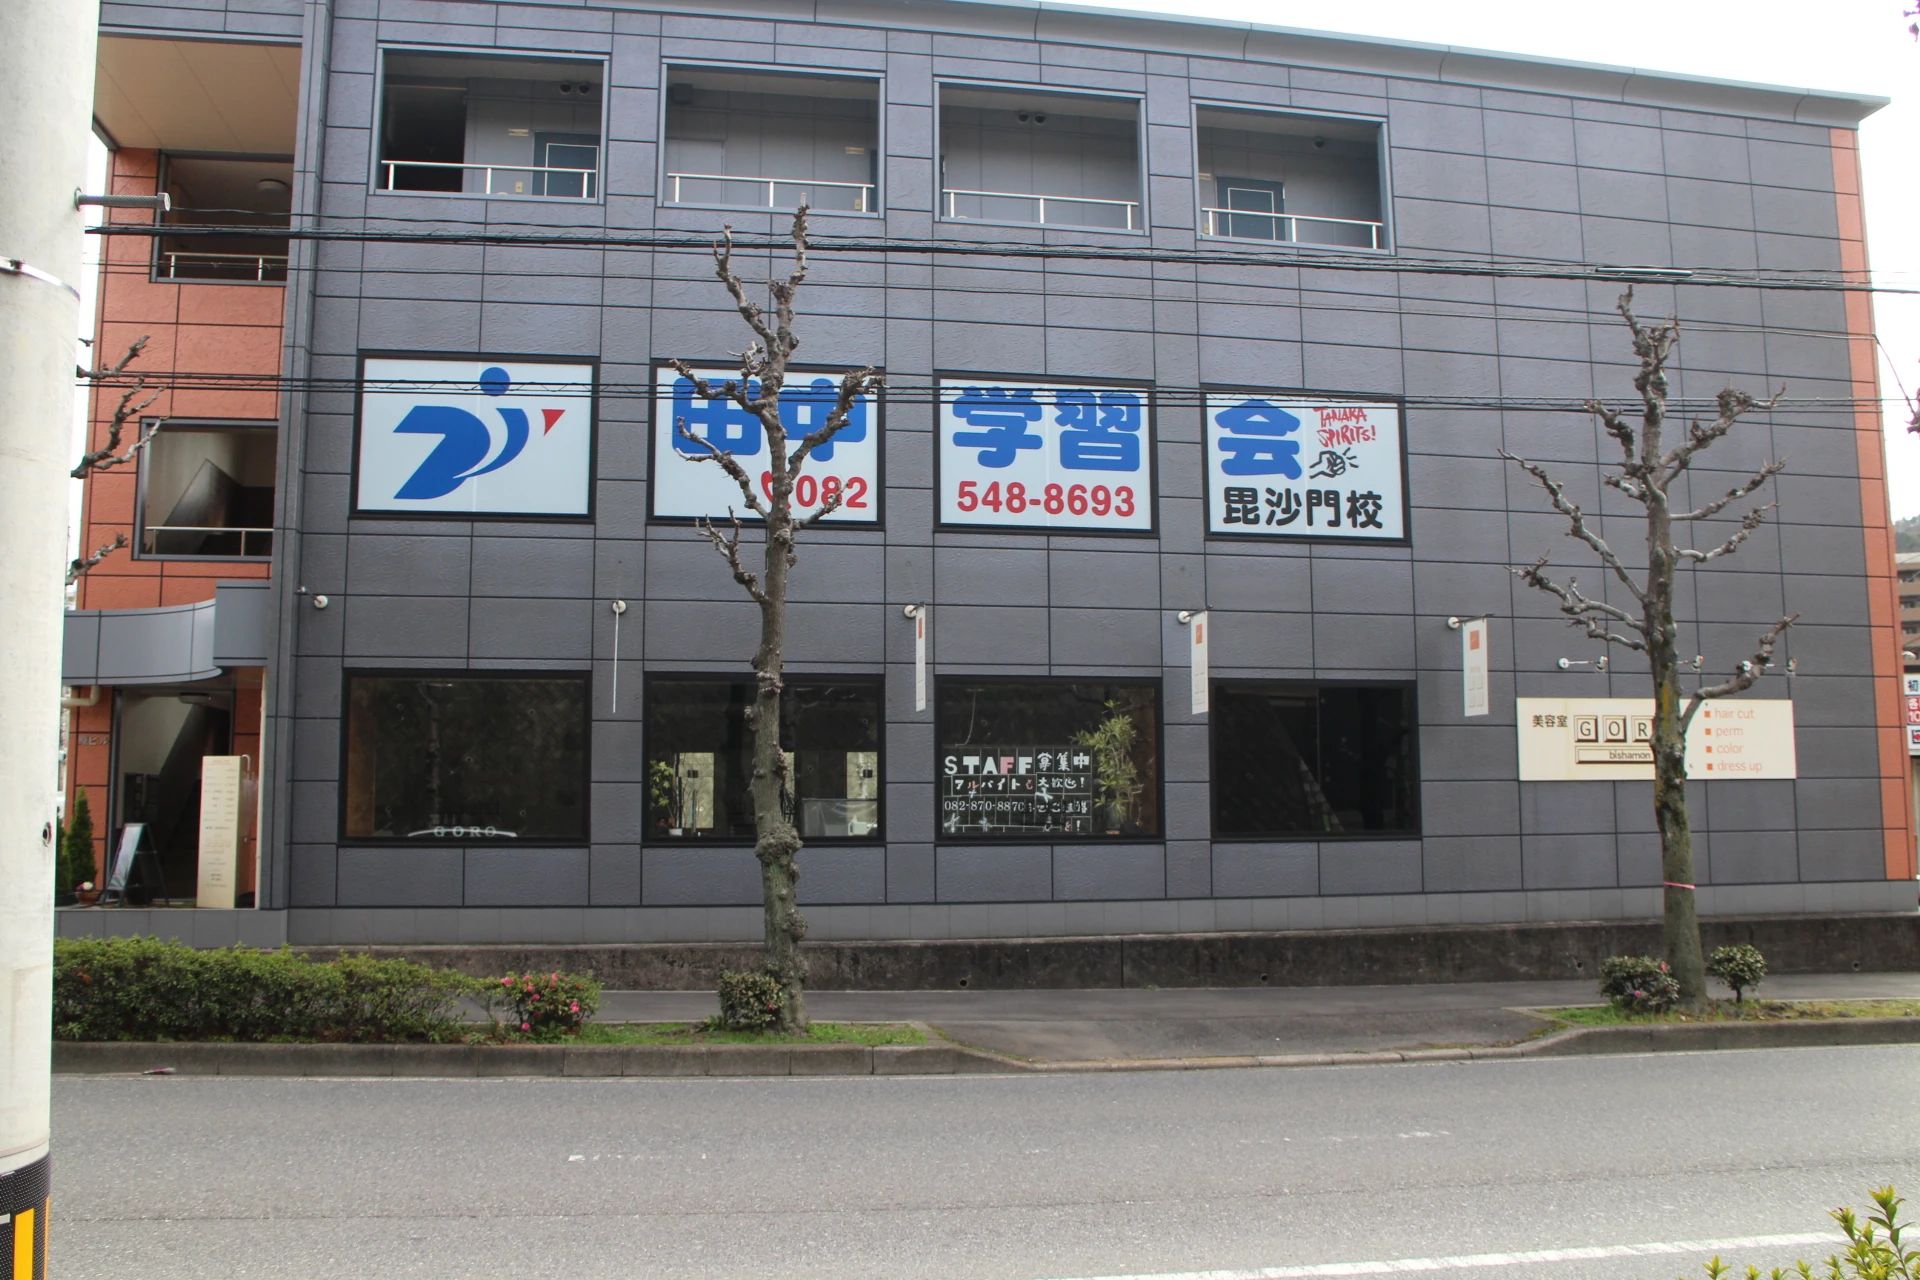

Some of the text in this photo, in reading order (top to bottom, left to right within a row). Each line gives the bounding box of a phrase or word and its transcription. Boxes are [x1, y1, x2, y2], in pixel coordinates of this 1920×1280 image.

[1313, 406, 1367, 428] TANAKA
[672, 377, 1302, 480] 田中 学習 会
[796, 475, 1136, 518] 082 548-8693
[1223, 486, 1384, 530] 毘沙門校
[1715, 706, 1756, 719] hair cut
[1532, 714, 1568, 728] 美容室
[1716, 728, 1744, 737] perm
[1609, 750, 1651, 760] bishamon
[1717, 744, 1744, 754] color
[944, 756, 1033, 775] STAFF
[1718, 761, 1762, 774] dress up
[434, 826, 496, 837] GORO
